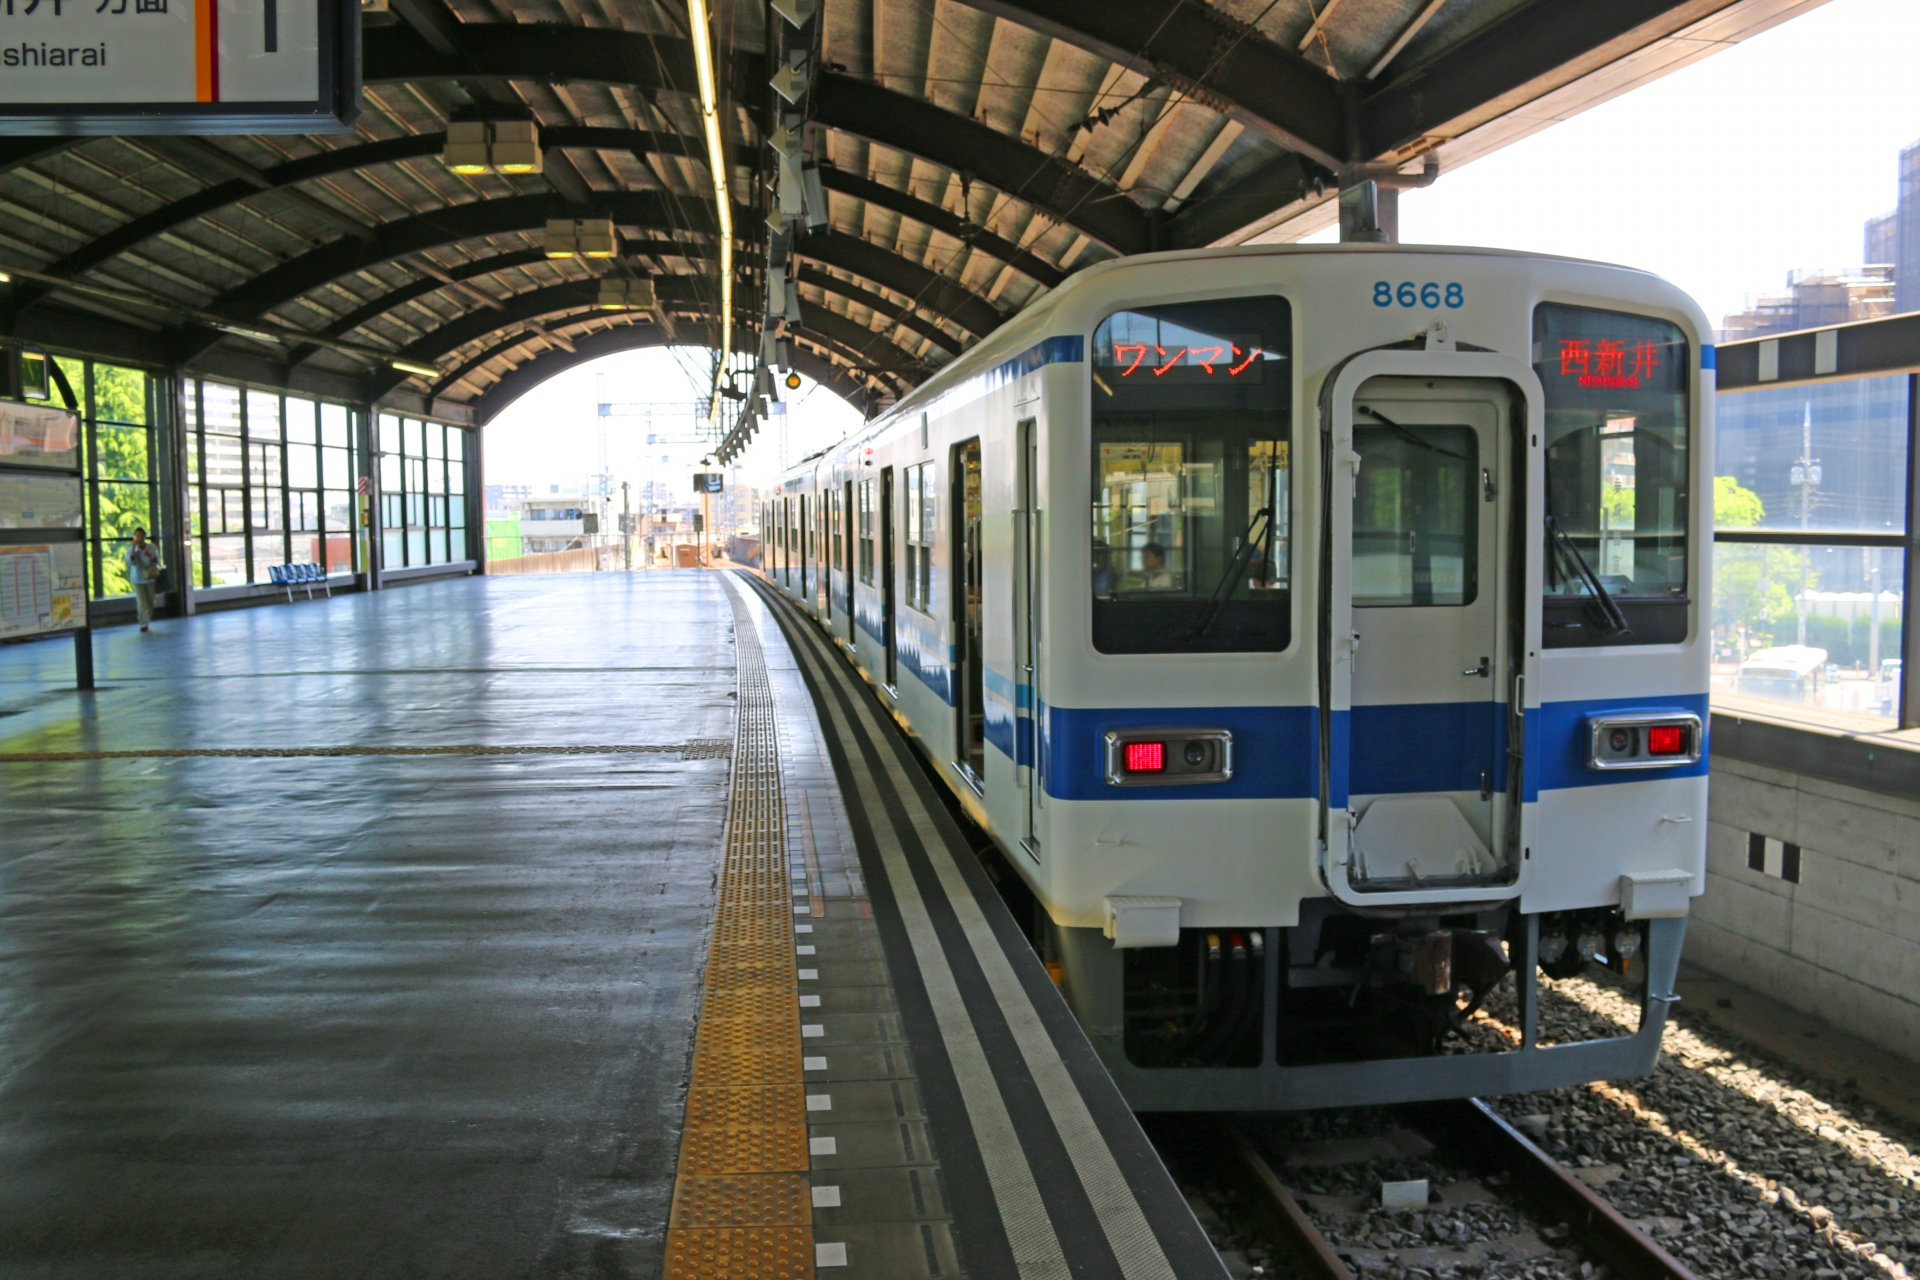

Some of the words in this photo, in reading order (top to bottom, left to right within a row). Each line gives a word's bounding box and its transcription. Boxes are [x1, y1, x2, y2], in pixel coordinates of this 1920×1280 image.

[1372, 281, 1464, 309] 8668
[1113, 343, 1262, 376] ワンマン
[1559, 339, 1659, 378] 西新井
[1578, 375, 1639, 390] NISHIARAI
